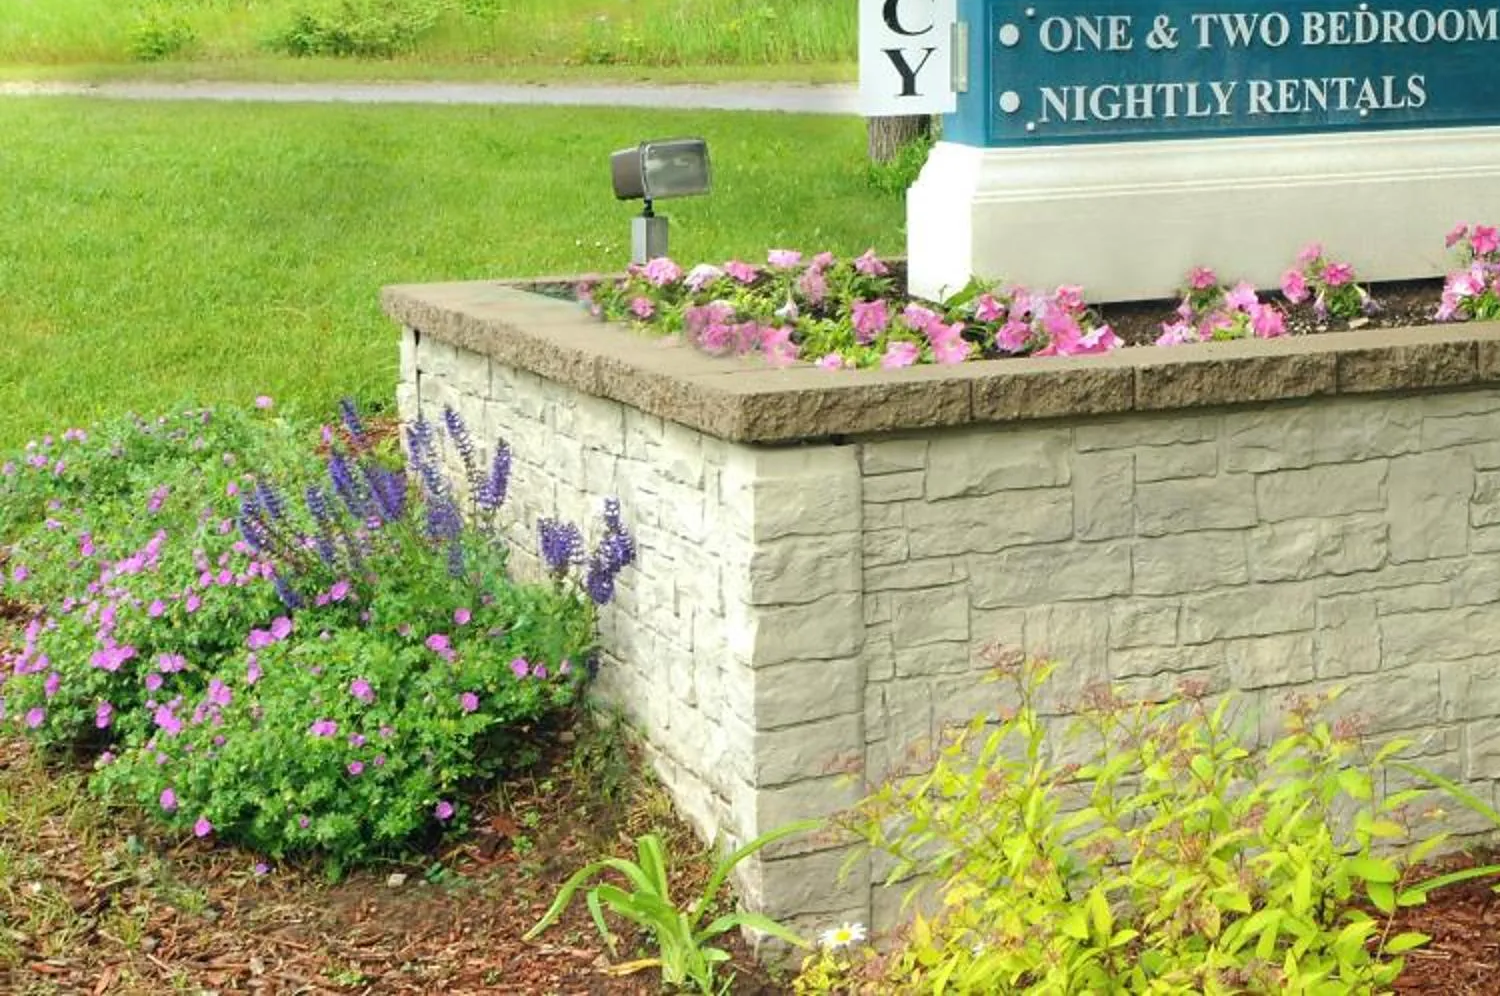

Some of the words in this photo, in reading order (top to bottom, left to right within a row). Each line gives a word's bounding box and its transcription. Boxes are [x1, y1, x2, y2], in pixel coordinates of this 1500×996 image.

[1039, 13, 1133, 53] ONE
[1145, 13, 1180, 50] &
[1192, 12, 1289, 49] TWO
[1301, 7, 1499, 46] BEDROOM
[1039, 80, 1237, 123] NIGHTLY
[1248, 74, 1426, 115] RENTALS
